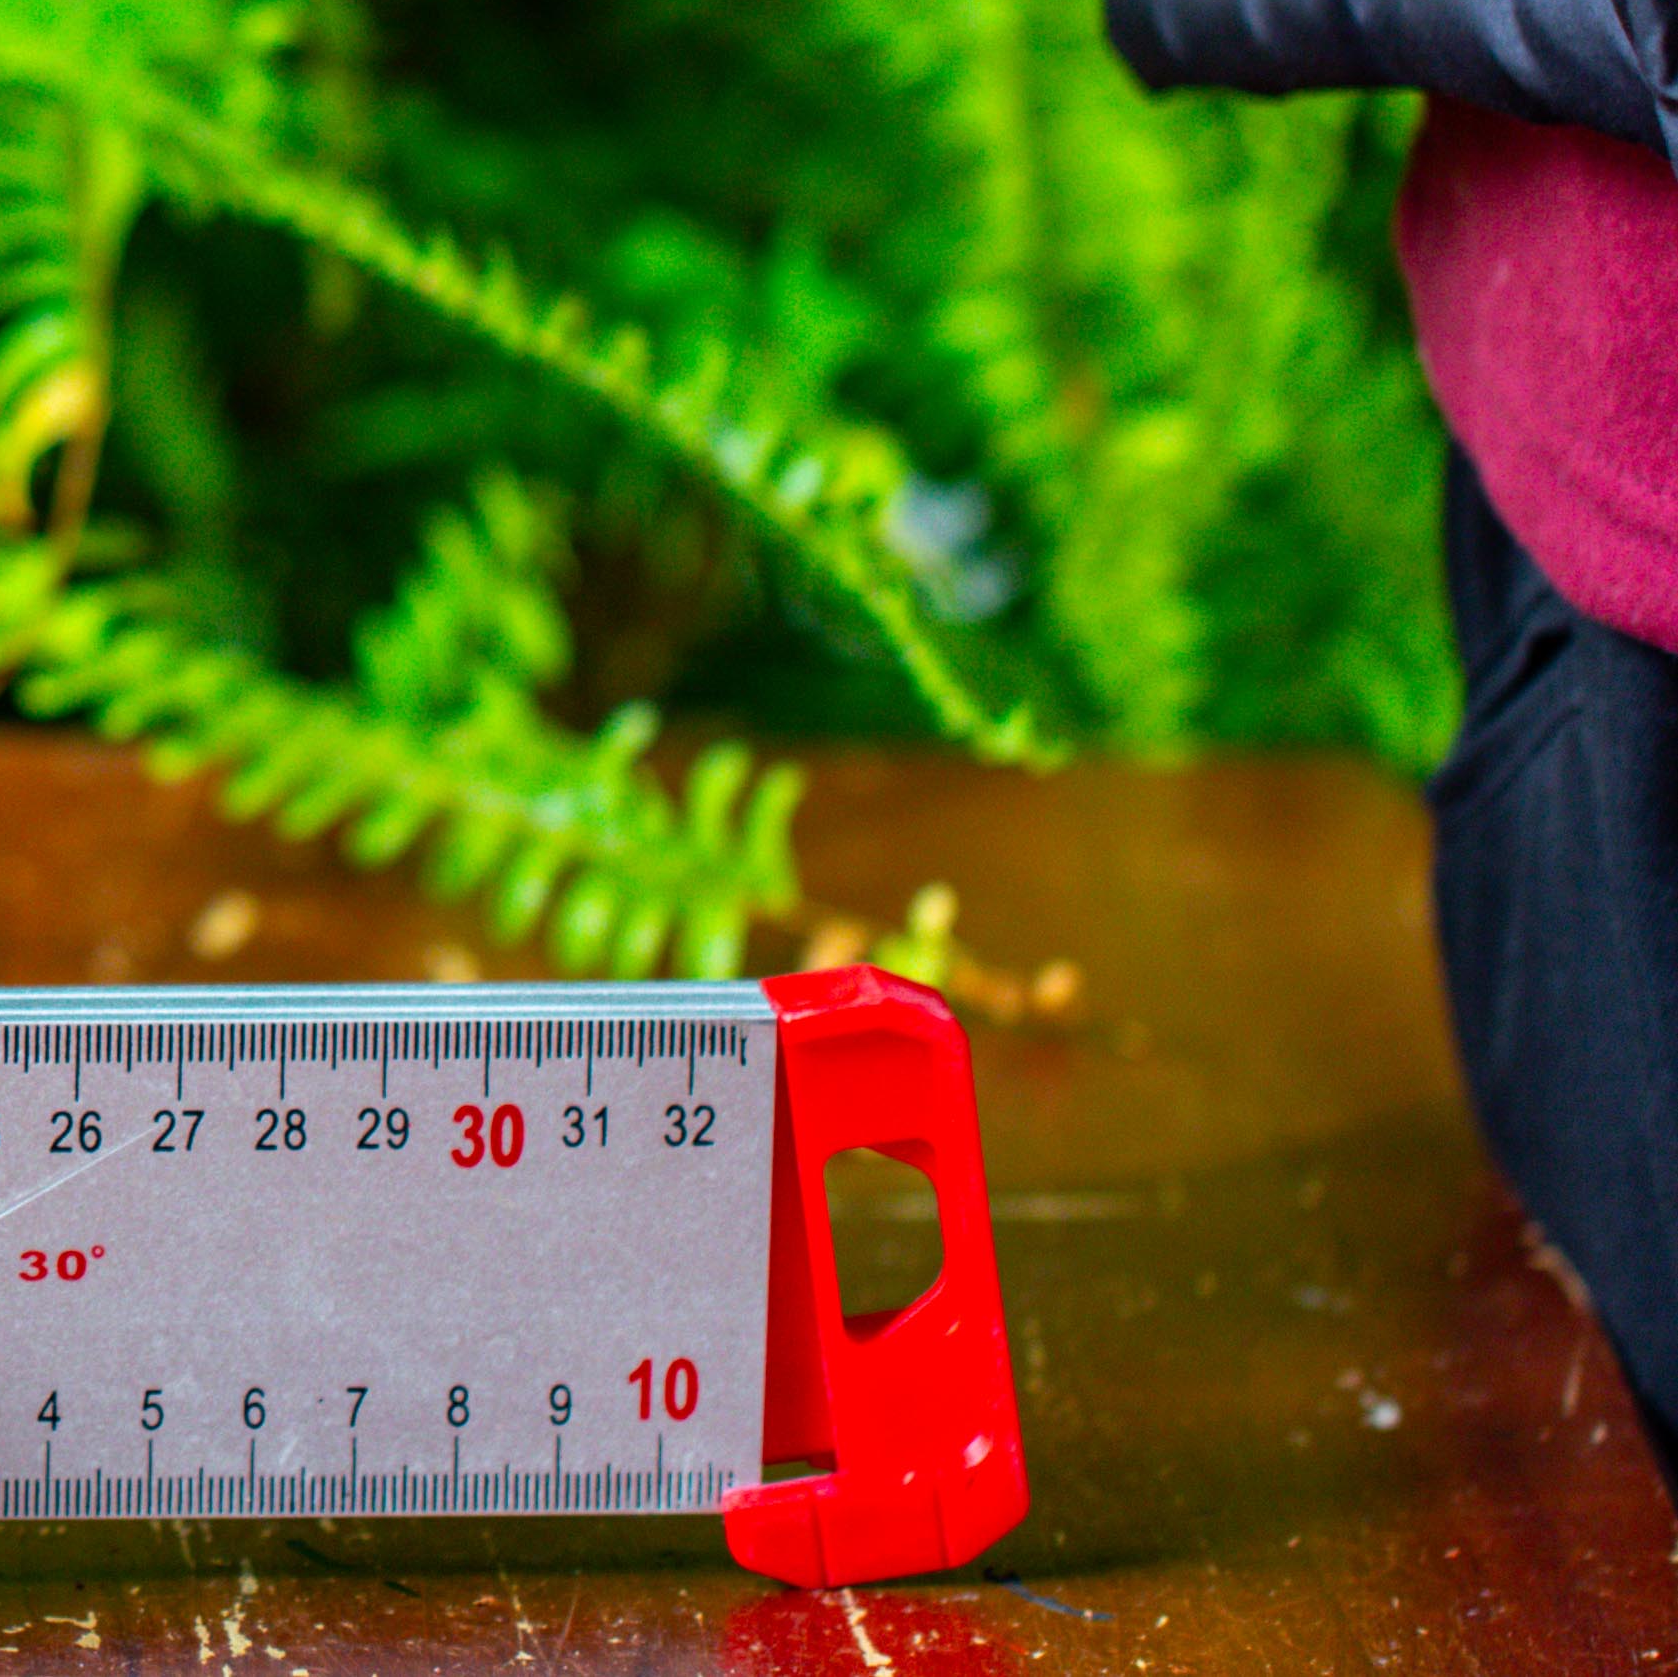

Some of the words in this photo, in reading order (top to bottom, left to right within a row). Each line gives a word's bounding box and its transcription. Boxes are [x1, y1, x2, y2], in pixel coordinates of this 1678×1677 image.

[50, 1111, 101, 1153] 26
[153, 1110, 204, 1152] 27
[255, 1109, 306, 1150] 28
[357, 1108, 409, 1149] 29
[451, 1104, 524, 1168] 30
[562, 1106, 607, 1147] 31
[664, 1104, 715, 1147] 32
[37, 1391, 61, 1431] 4
[141, 1389, 164, 1431] 5
[243, 1387, 265, 1429] 6
[347, 1386, 368, 1427] 7
[447, 1385, 469, 1427] 8
[549, 1384, 572, 1426] 9
[629, 1358, 698, 1421] 10
